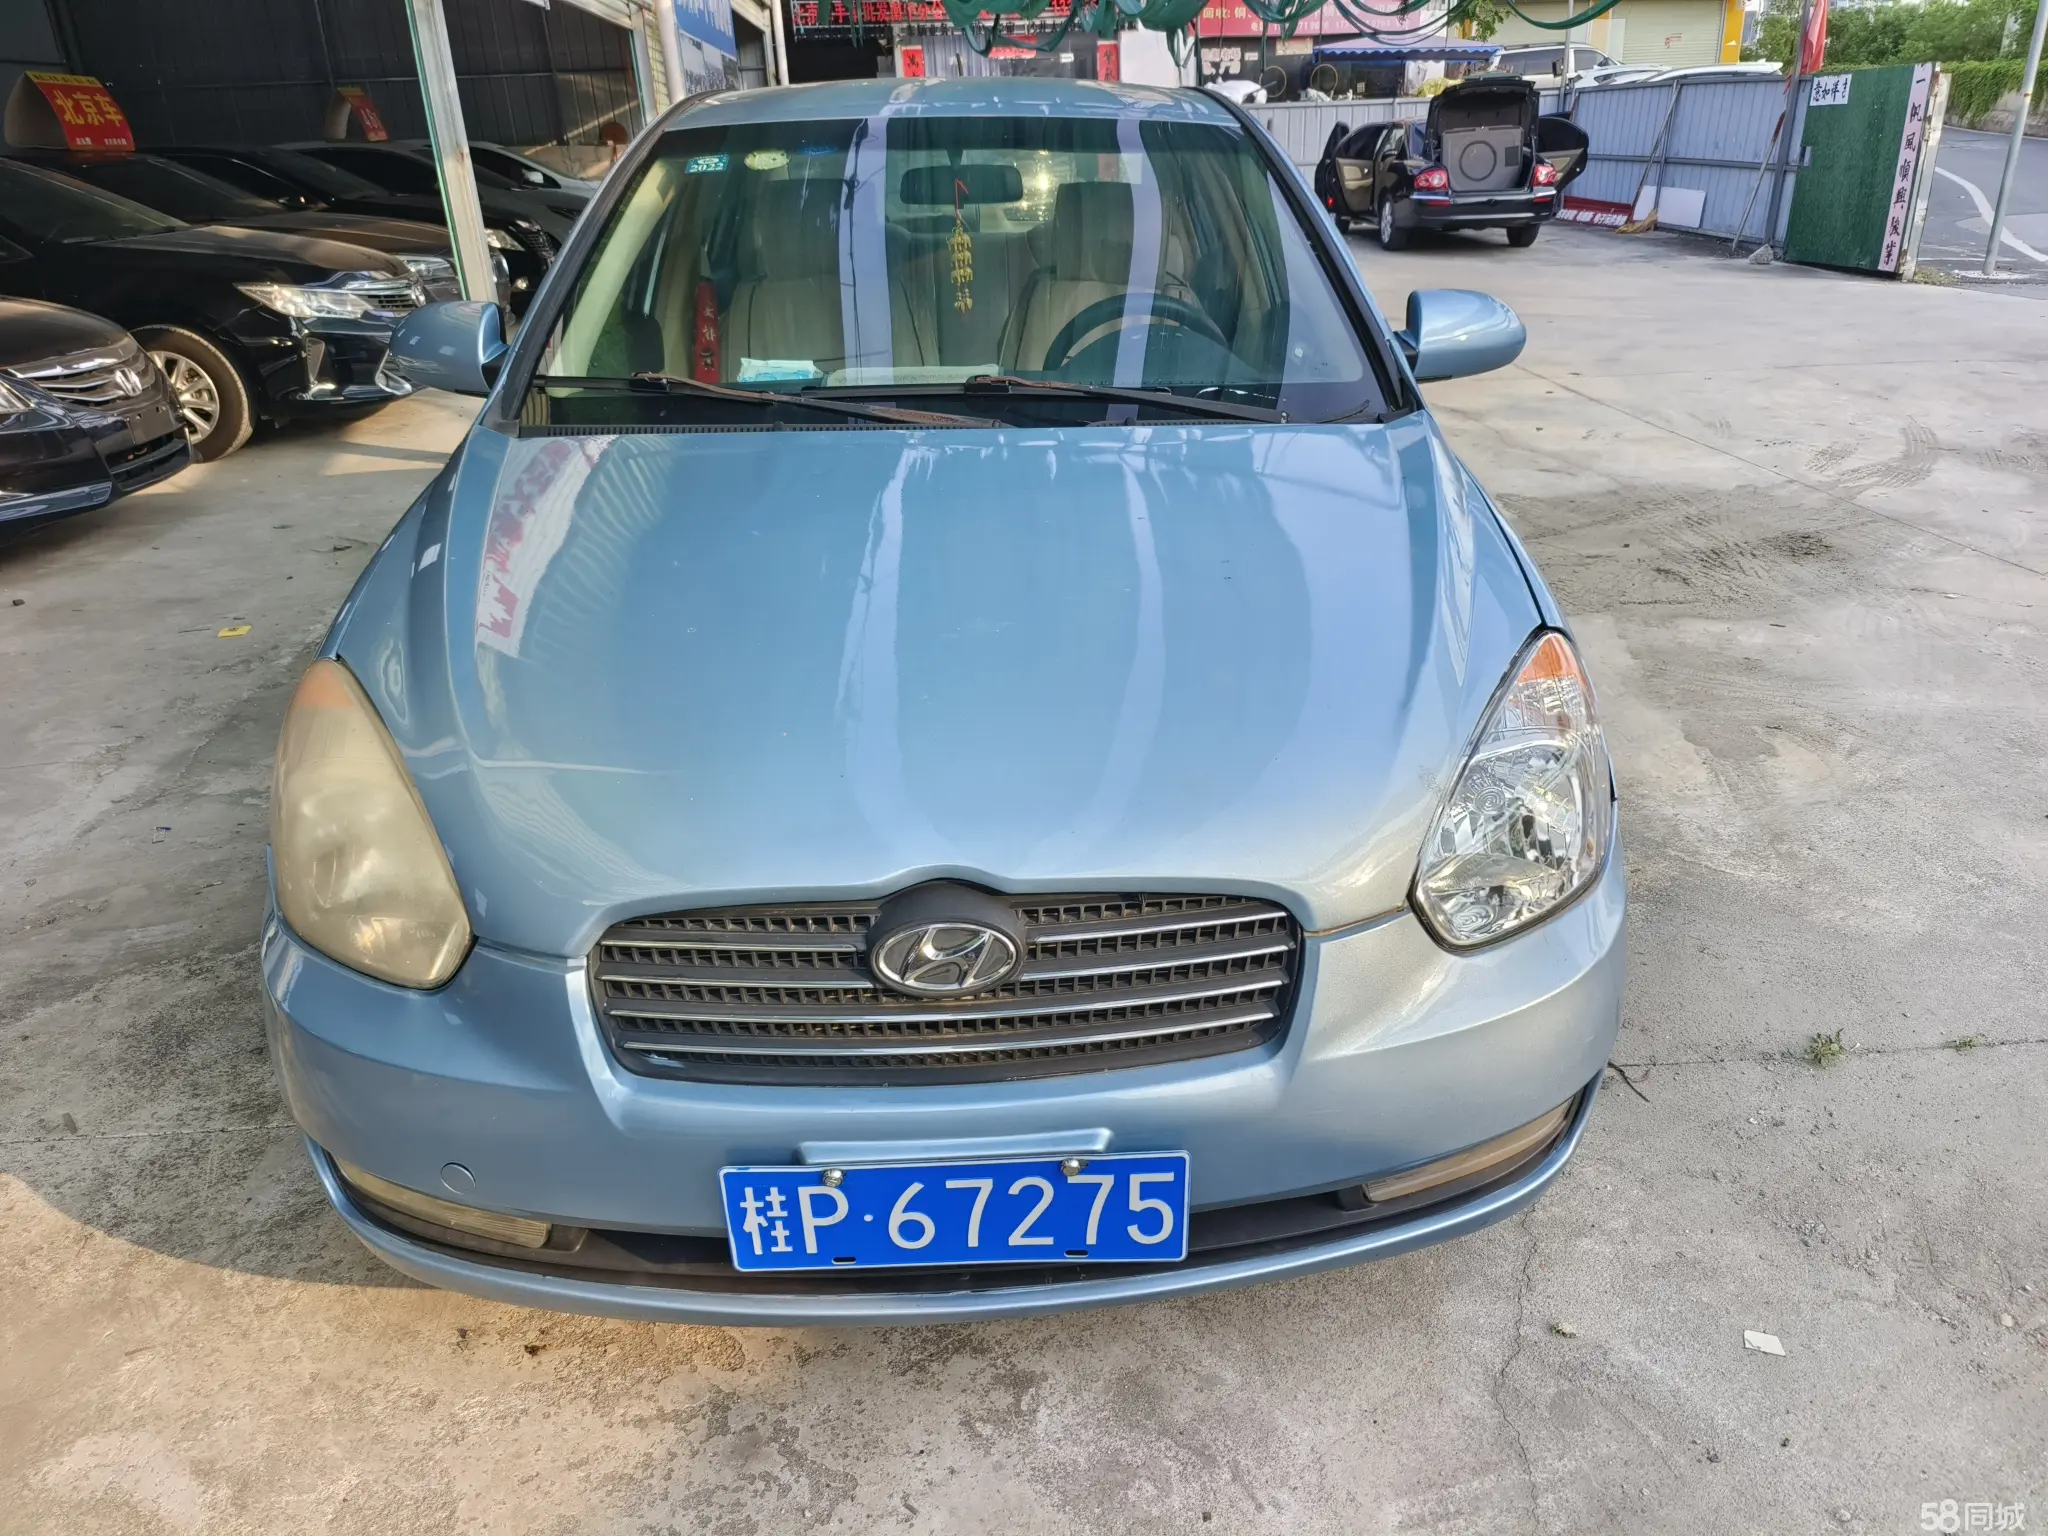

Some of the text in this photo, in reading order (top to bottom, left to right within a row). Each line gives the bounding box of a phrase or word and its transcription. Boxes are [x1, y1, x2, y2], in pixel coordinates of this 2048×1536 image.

[53, 90, 123, 127] 北京车
[689, 162, 724, 173] 2022
